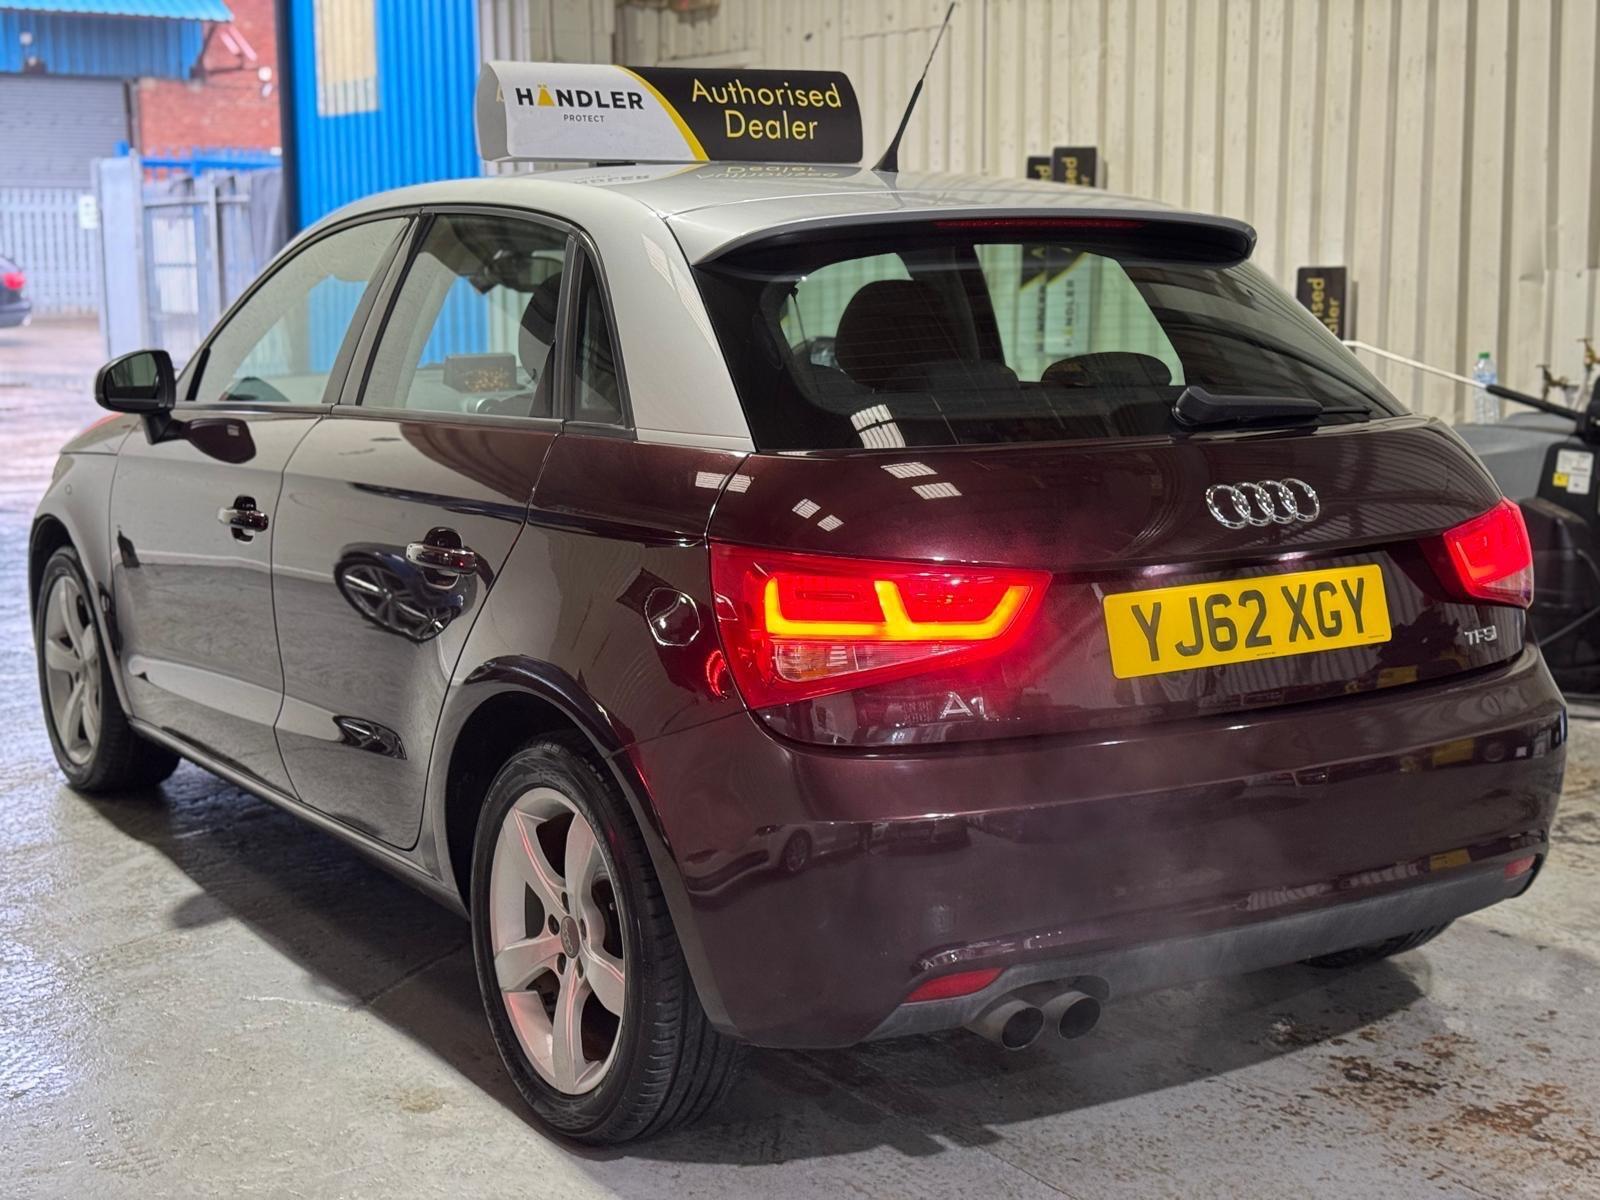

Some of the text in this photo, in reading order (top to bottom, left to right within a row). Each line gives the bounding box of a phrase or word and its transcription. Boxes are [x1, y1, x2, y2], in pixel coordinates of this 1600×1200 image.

[516, 83, 645, 109] HÄNDLER
[692, 78, 843, 108] Authorised
[563, 114, 605, 123] PROTECT
[725, 110, 819, 141] Dealer
[1131, 577, 1365, 662] YJ62 XGY
[1464, 625, 1497, 645] TFSI
[939, 691, 988, 720] A1
